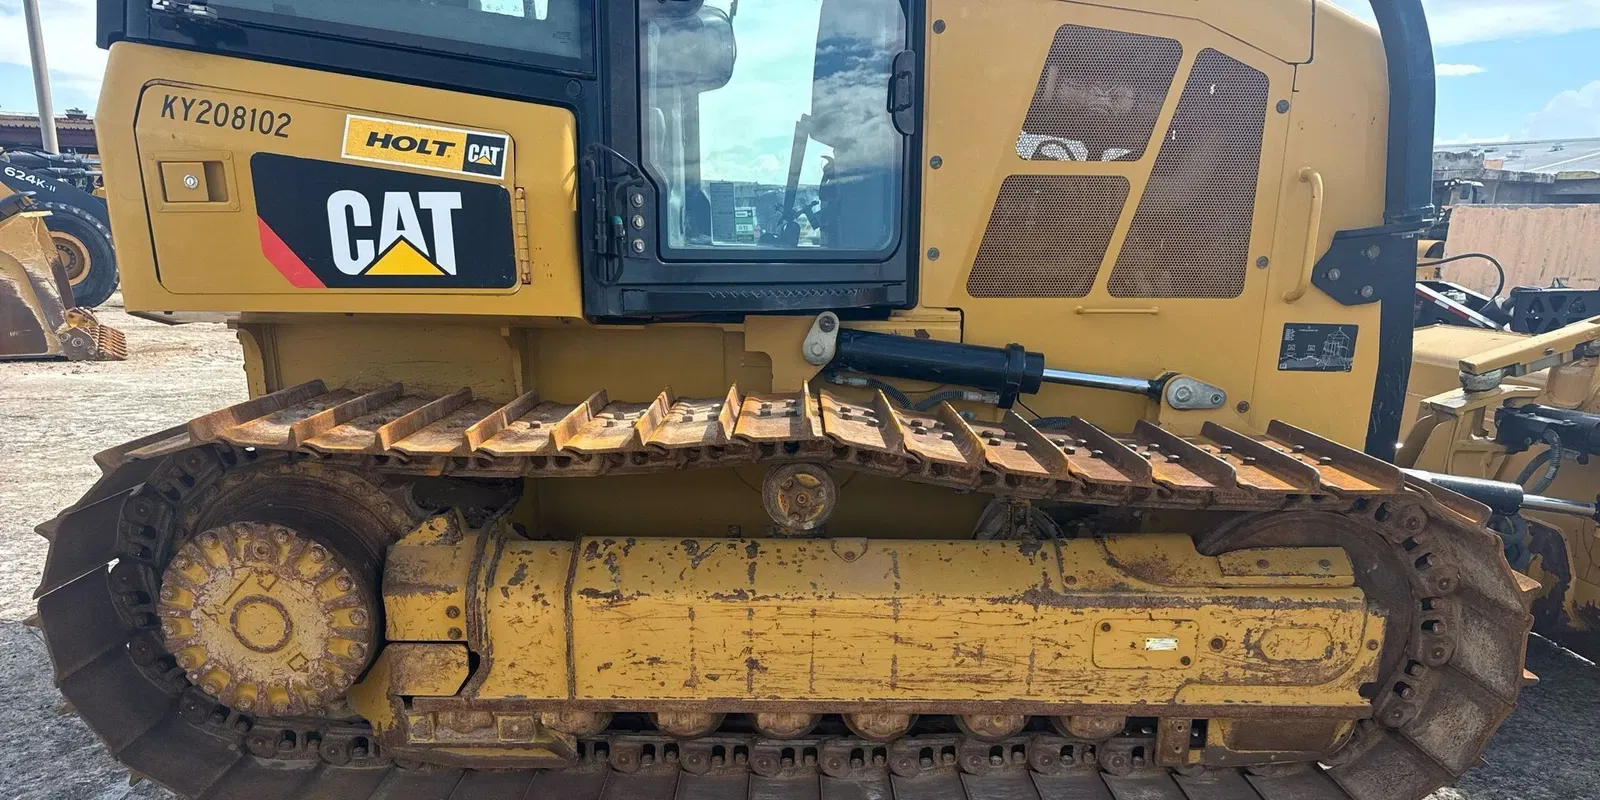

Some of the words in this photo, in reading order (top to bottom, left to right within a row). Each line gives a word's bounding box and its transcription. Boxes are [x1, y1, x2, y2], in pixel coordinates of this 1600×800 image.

[161, 95, 291, 138] KY208102
[366, 131, 456, 157] HOLT
[468, 143, 500, 166] CAT
[326, 190, 462, 276] CAT
